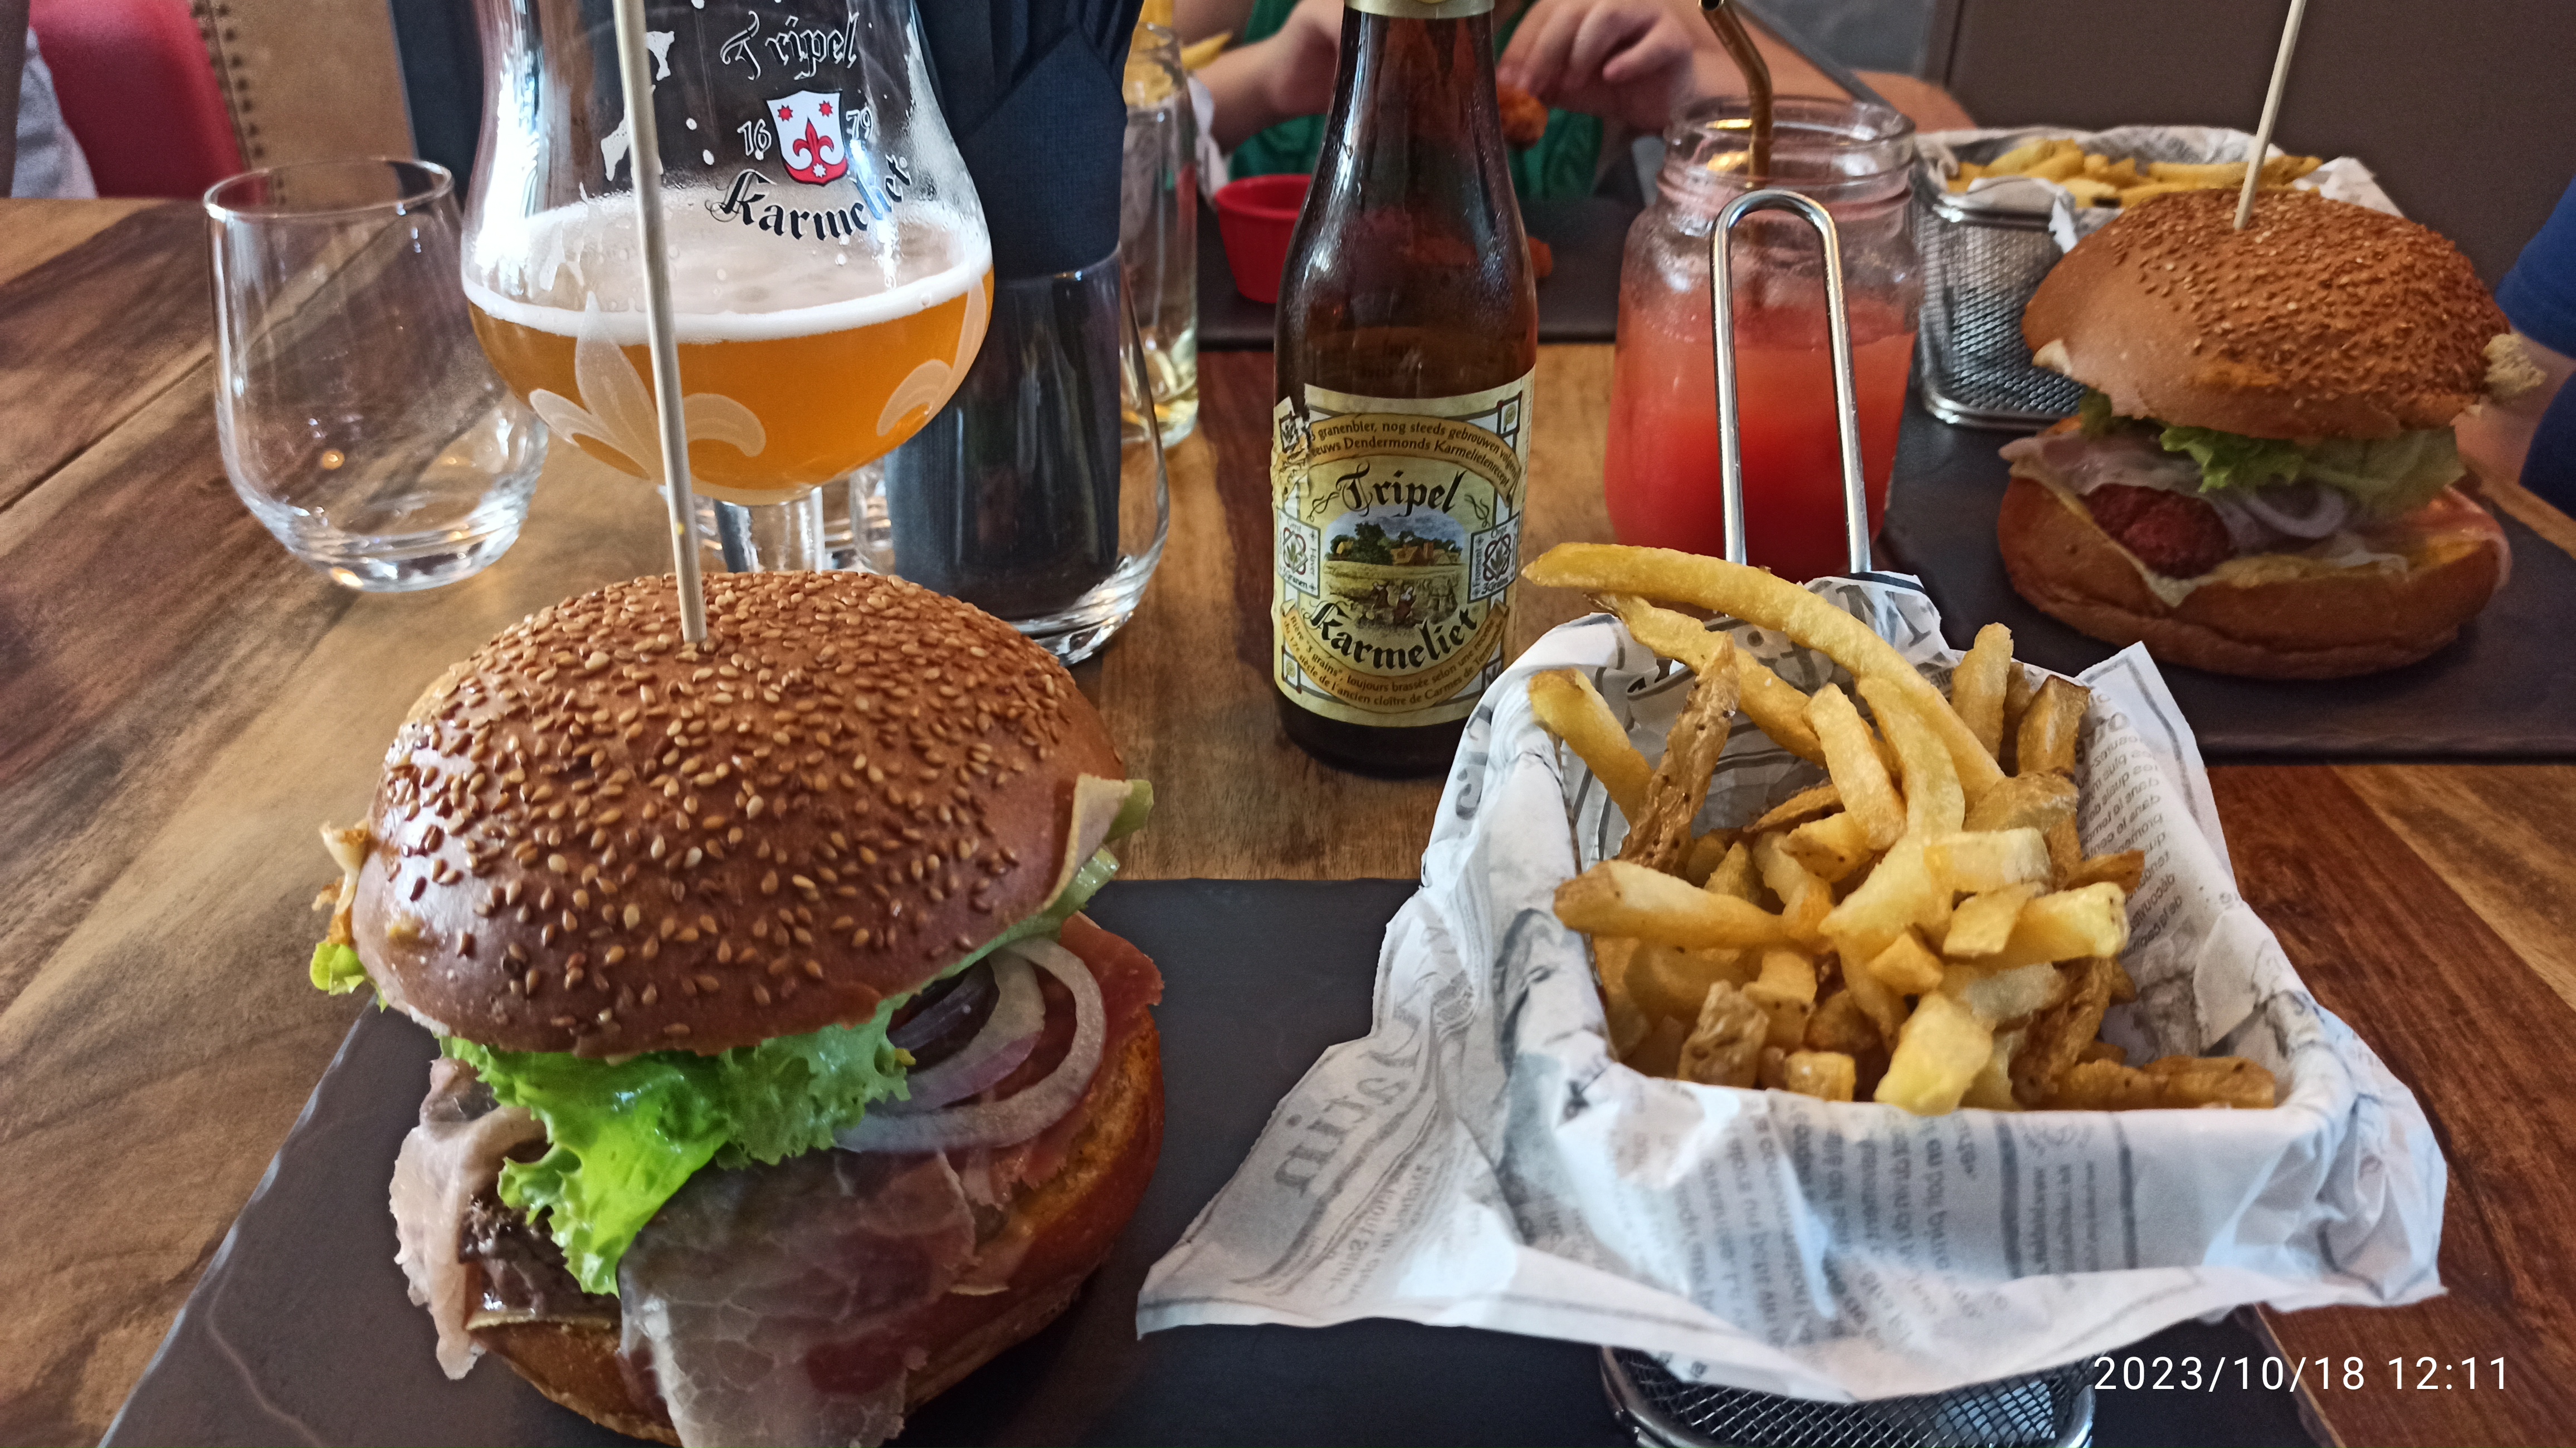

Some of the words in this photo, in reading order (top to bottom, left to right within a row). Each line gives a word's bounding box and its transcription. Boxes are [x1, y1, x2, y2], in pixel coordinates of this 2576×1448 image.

[720, 11, 859, 81] Tripel
[737, 119, 772, 156] 16
[846, 106, 874, 141] 79
[1343, 436, 1431, 449] Dendermonds
[1382, 423, 1406, 435] nog
[1410, 422, 1446, 436] steeds
[1448, 427, 1500, 454] gebrouwen
[1335, 461, 1468, 517] Tripel
[1302, 600, 1477, 670] Karmeliet
[1319, 674, 1331, 686] de
[1409, 693, 1422, 703] de
[1424, 677, 1463, 699] Carmes
[1463, 666, 1474, 678] de
[1347, 674, 1389, 692] toujours
[1392, 677, 1430, 692] brassée
[1431, 664, 1457, 683] selon
[1457, 650, 1474, 666] une
